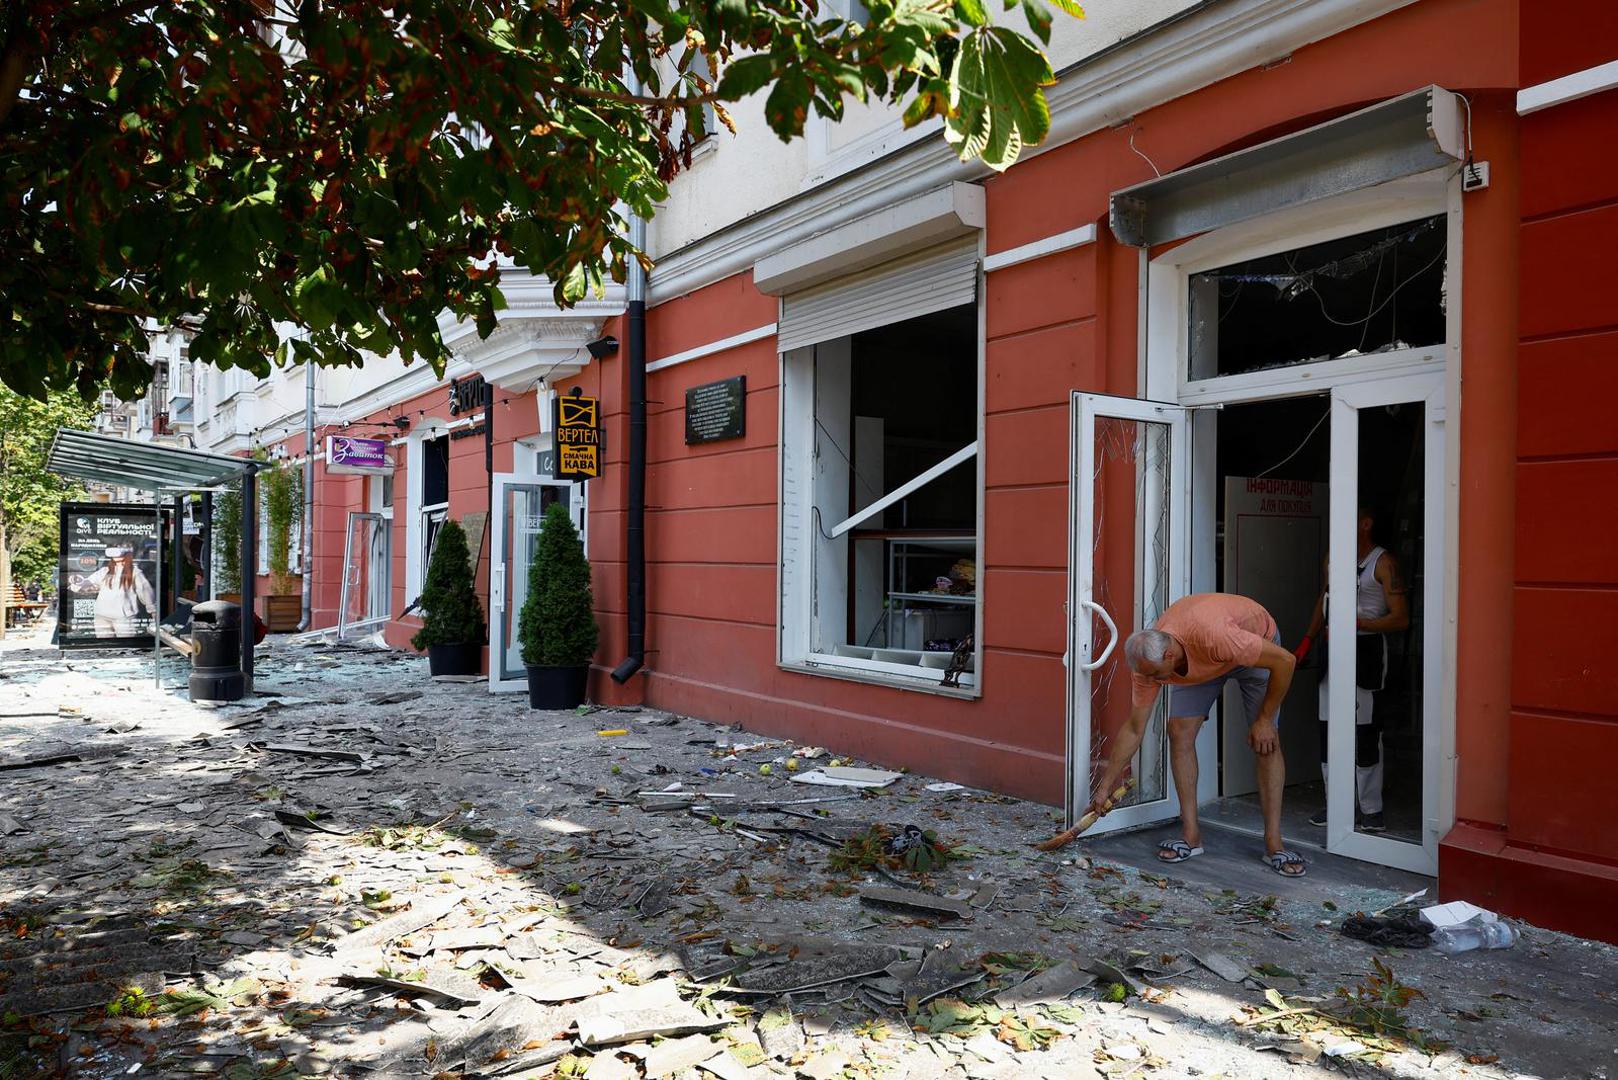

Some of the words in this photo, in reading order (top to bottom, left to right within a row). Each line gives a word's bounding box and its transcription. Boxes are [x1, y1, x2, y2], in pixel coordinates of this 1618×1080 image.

[558, 428, 598, 443] ВЕРТЕЛ
[333, 439, 383, 463] Завиток
[565, 460, 594, 469] КАВА
